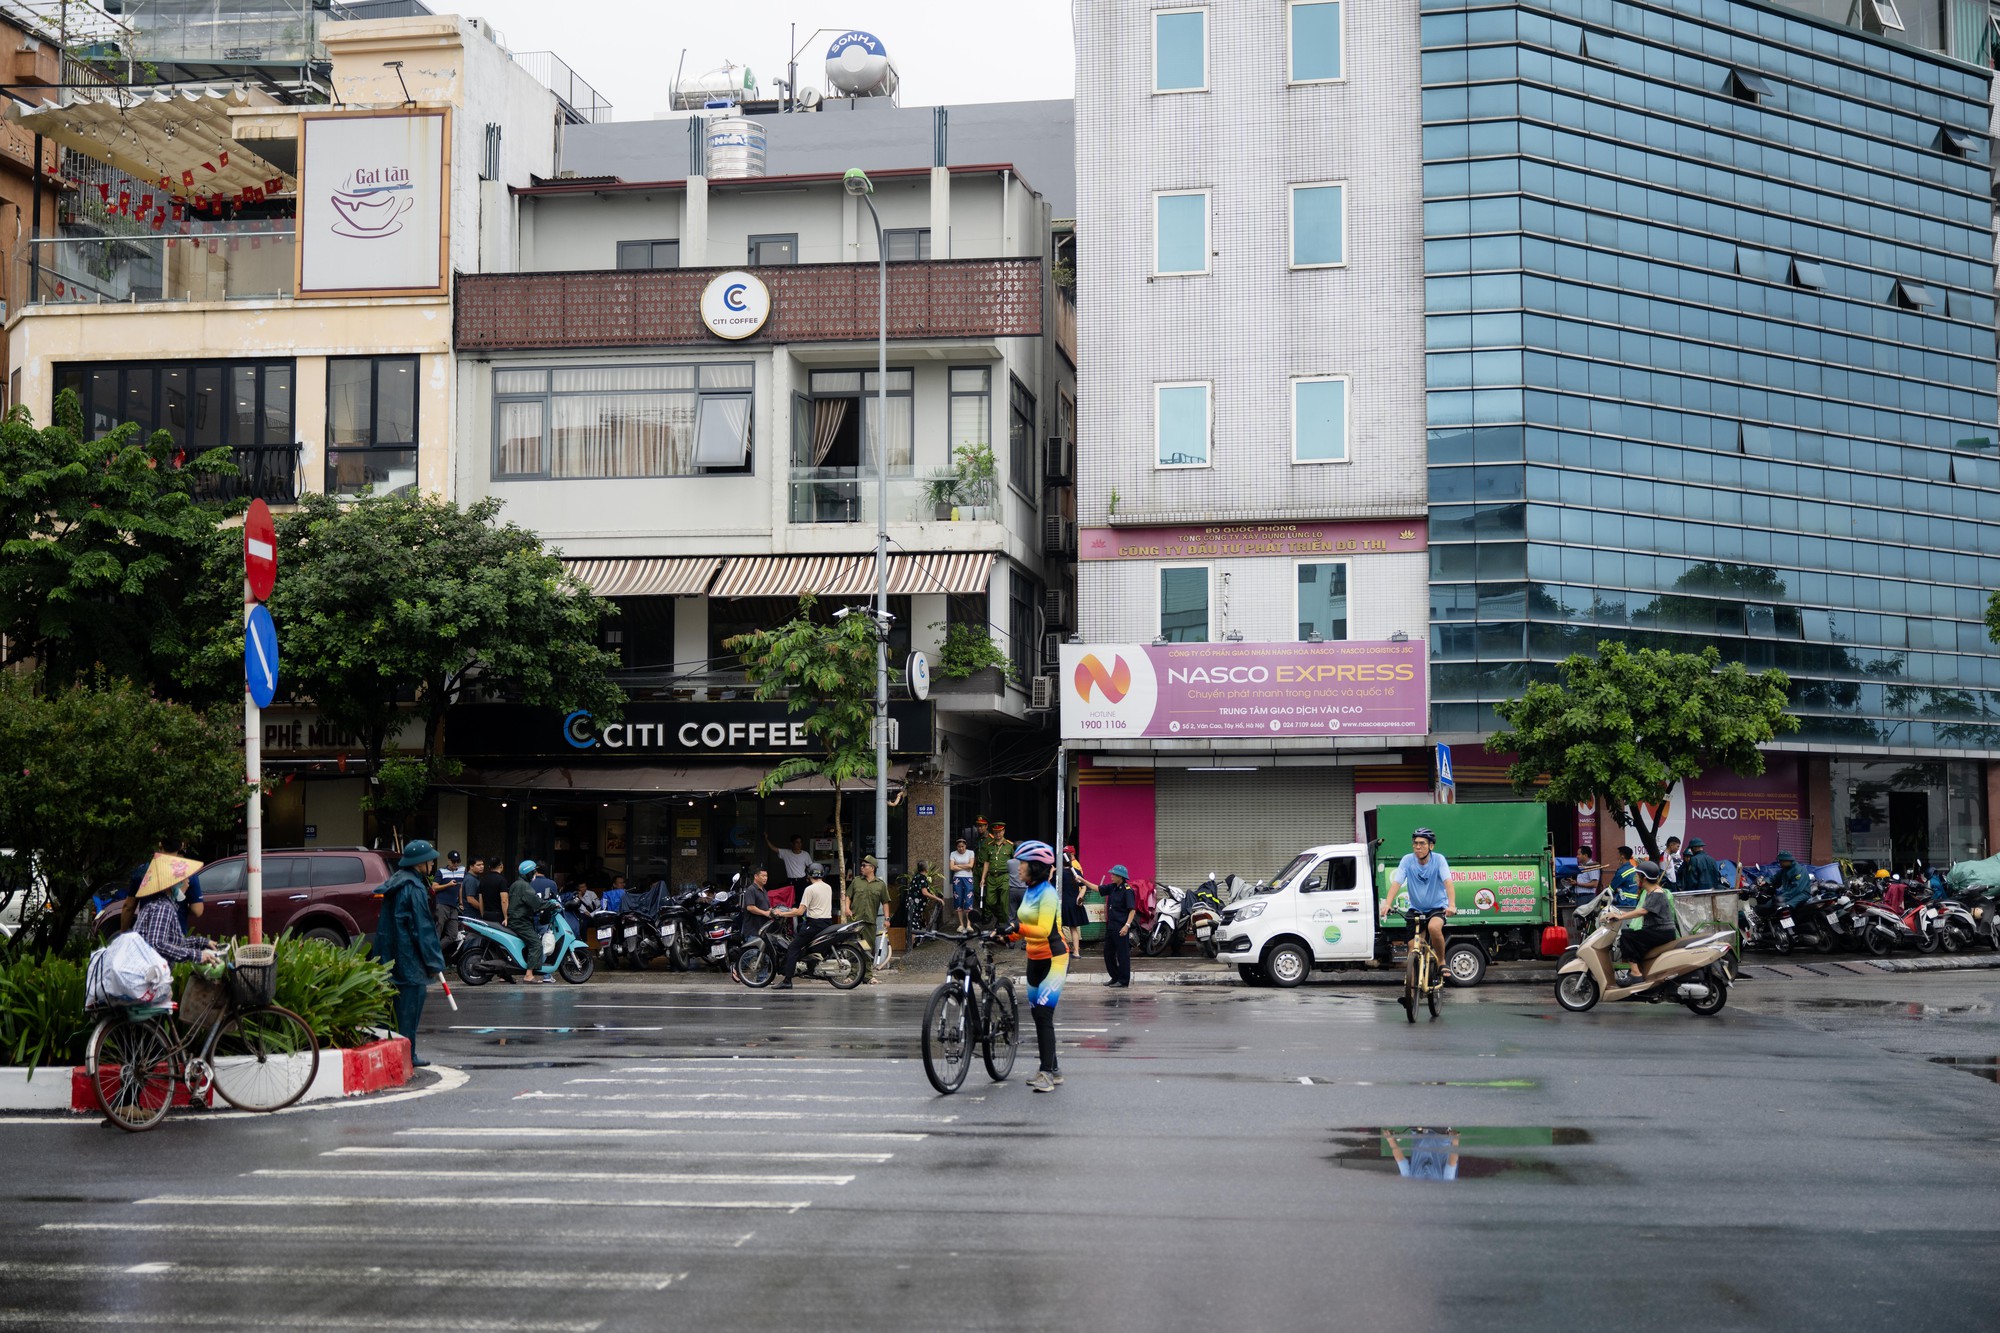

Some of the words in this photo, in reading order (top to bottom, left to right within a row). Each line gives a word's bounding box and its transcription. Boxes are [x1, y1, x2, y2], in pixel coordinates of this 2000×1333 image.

[831, 33, 876, 53] SONHA
[355, 168, 381, 187] Gạt
[729, 317, 758, 325] COFFEE
[1118, 544, 1160, 557] CÔNG
[1165, 545, 1183, 556] TY
[1336, 539, 1357, 551] ĐÔ
[1168, 649, 1190, 658] CÔNG
[1231, 649, 1250, 657] GIAO
[1272, 647, 1293, 656] HÀNG
[1366, 646, 1400, 654] LOGISTICS
[1401, 646, 1414, 654] JSC
[1168, 665, 1269, 684] NASCO
[1276, 663, 1415, 683] EXPRESS
[1187, 688, 1225, 700] Chuyển
[1227, 689, 1250, 699] phát
[1252, 688, 1283, 698] nhanh
[1285, 688, 1312, 699] trong
[1313, 687, 1338, 697] nước
[1341, 687, 1354, 697] và
[1356, 686, 1382, 698] quốc
[1384, 685, 1395, 696] tế
[1089, 710, 1116, 718] HOTLINE
[1219, 707, 1248, 715] TRUNG
[1250, 705, 1268, 715] TÂM
[1269, 706, 1294, 714] GIAO
[1296, 706, 1318, 716] DỊCH
[1319, 704, 1340, 714] VĂN
[1341, 705, 1363, 714] CAO
[1080, 720, 1102, 729] 1900
[1105, 719, 1127, 729] 1106
[1342, 720, 1416, 729] www.nascoexpress.com
[264, 719, 303, 748] PHÊ
[602, 722, 664, 748] CITI
[678, 721, 808, 748] COFFEE
[1691, 807, 1738, 820] NASCO
[1740, 808, 1799, 821] EXPRESS
[1467, 871, 1487, 881] XANH
[1493, 871, 1513, 883] SẠCH
[1518, 870, 1535, 883] ĐẸP!
[1498, 884, 1534, 895] KHÔNG:
